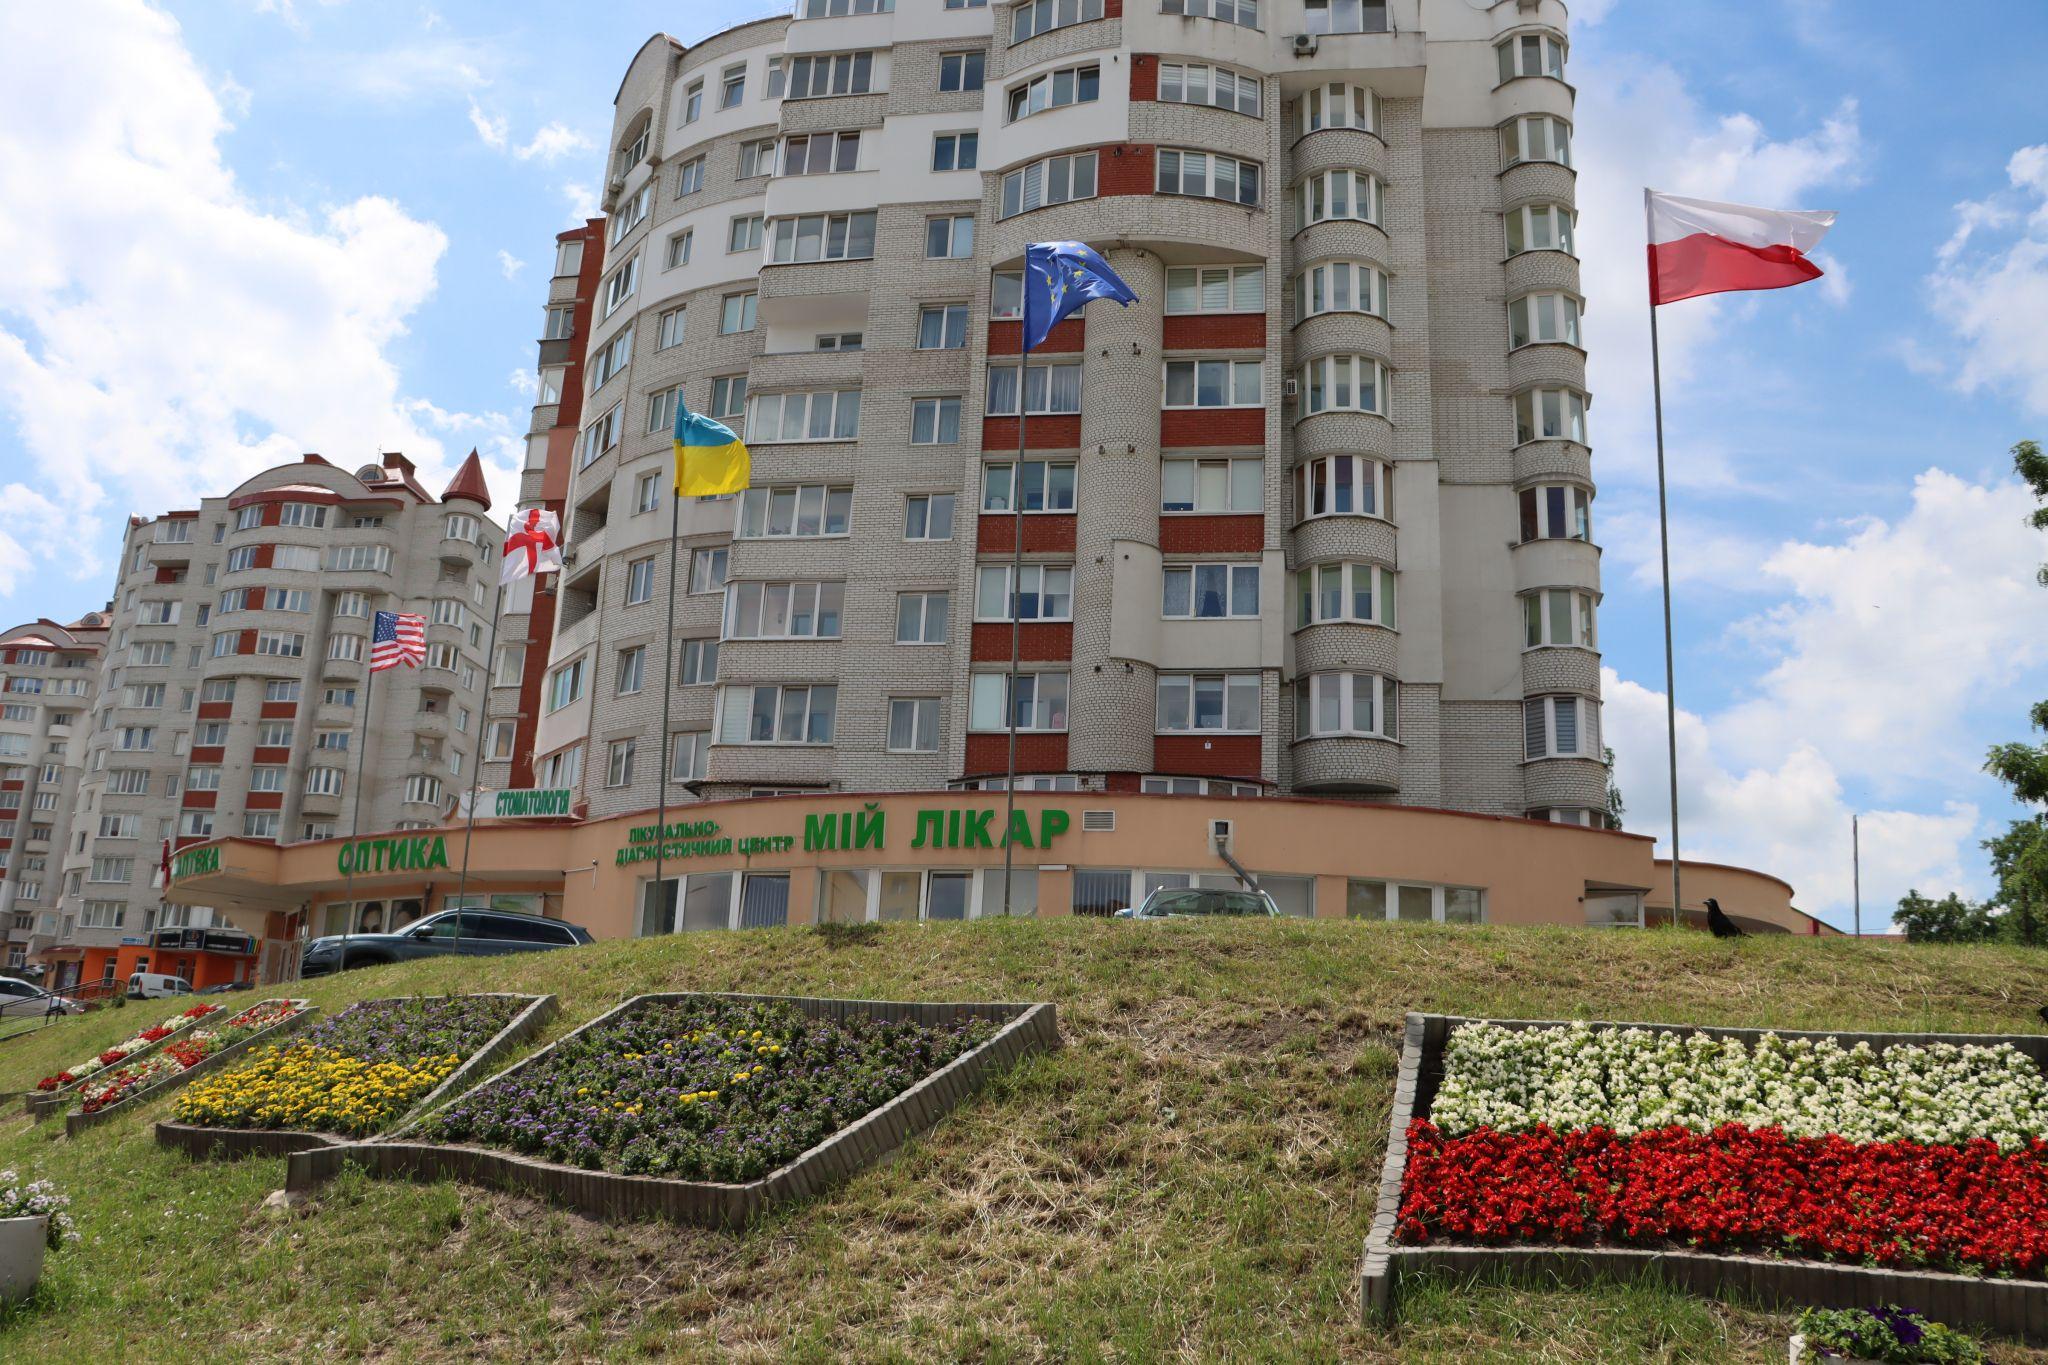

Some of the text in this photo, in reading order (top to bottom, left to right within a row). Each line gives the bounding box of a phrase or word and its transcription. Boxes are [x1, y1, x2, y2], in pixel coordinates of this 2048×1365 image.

[495, 790, 570, 816] СТОМАТОЛОГІЯ
[803, 802, 1070, 851] МІЙ ЛІКАР
[338, 836, 449, 875] ОПТИКА
[738, 836, 795, 854] ЦЕНТР
